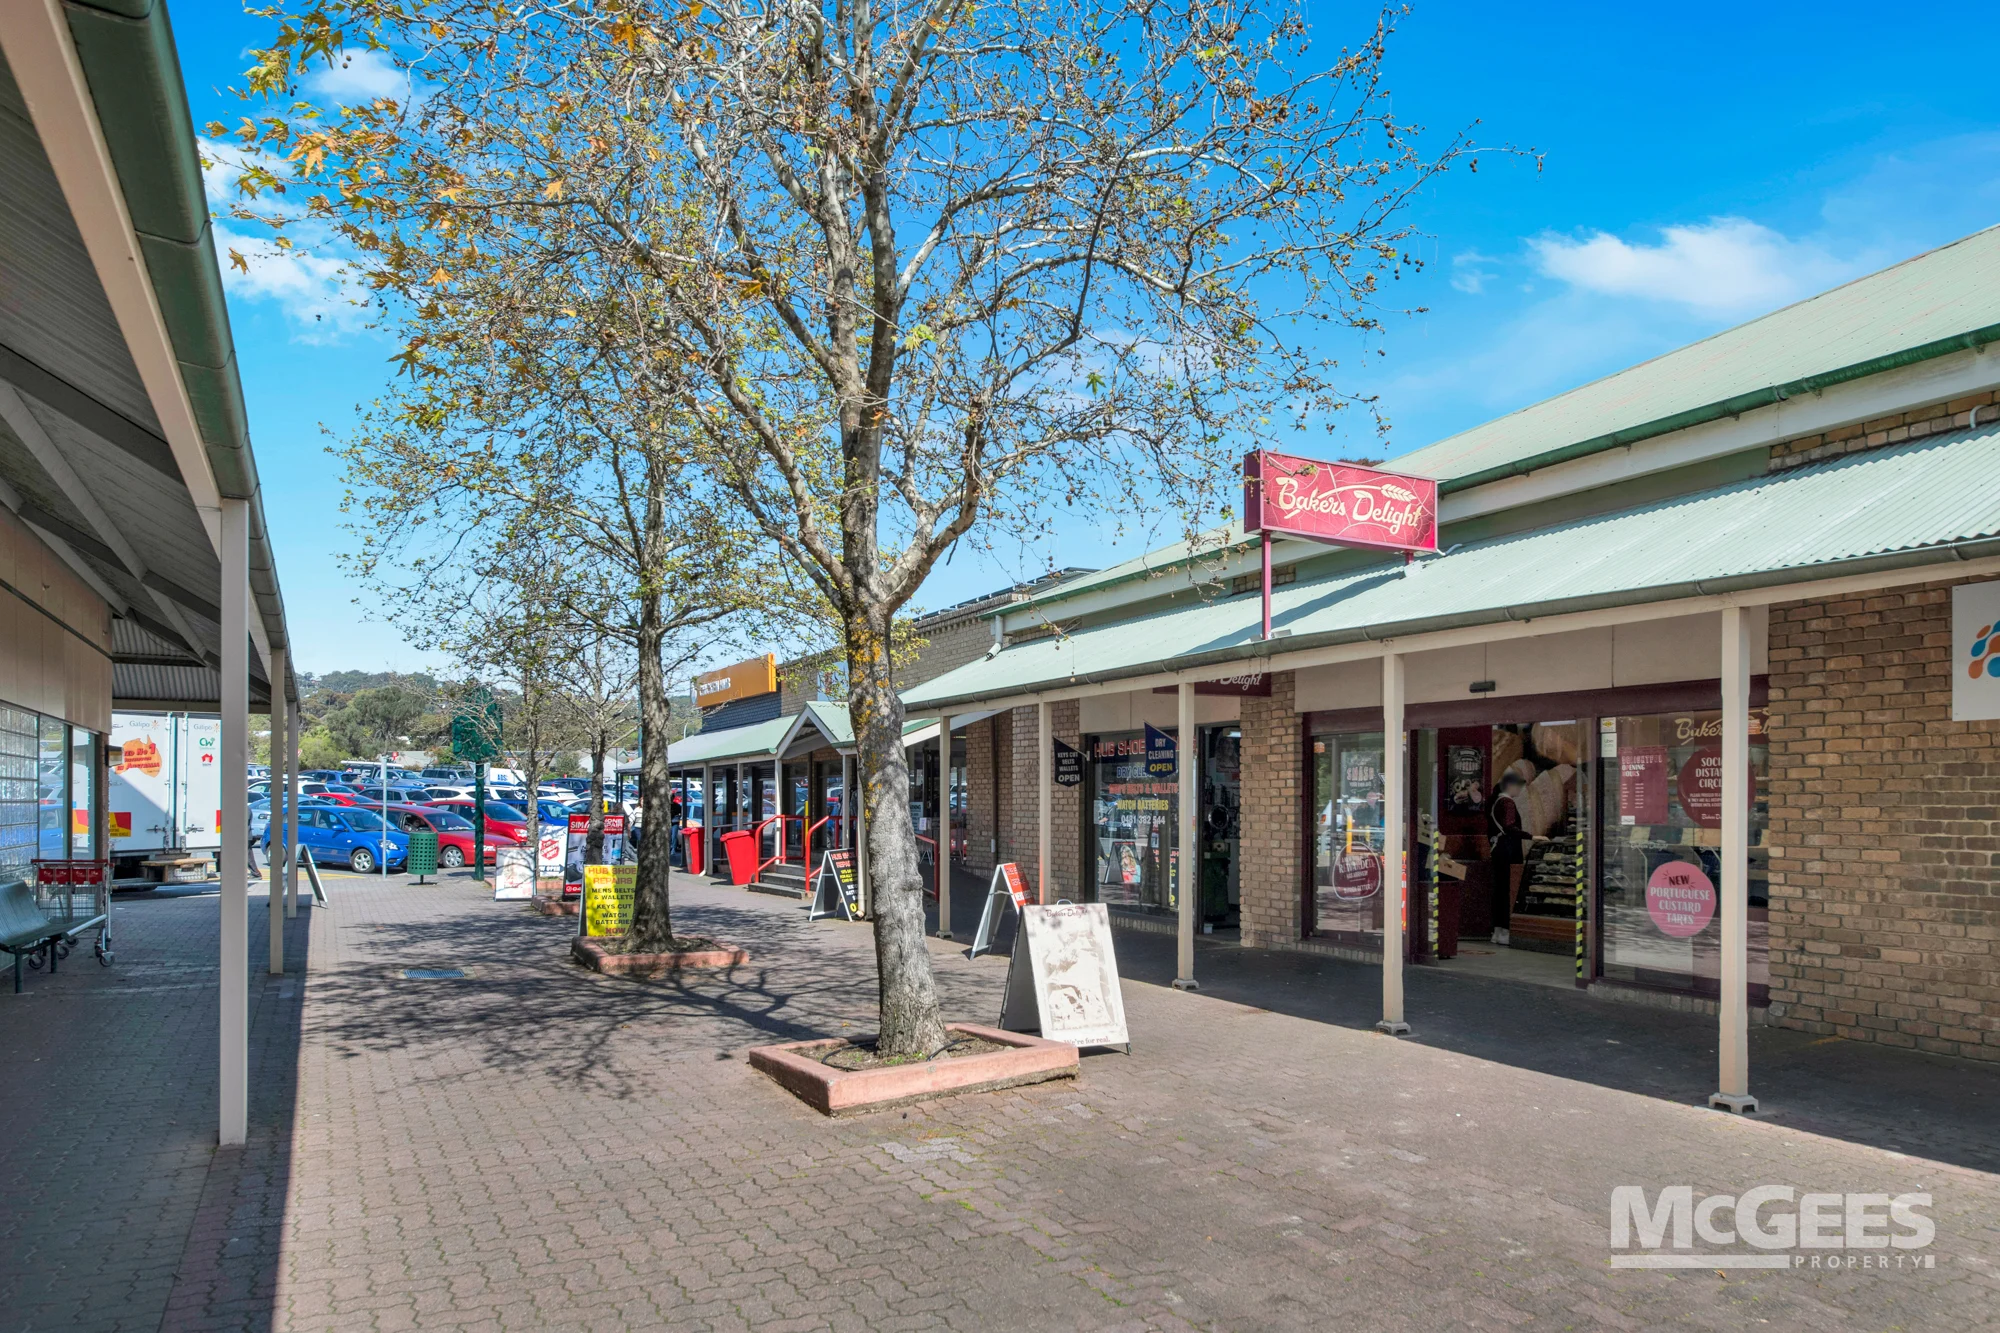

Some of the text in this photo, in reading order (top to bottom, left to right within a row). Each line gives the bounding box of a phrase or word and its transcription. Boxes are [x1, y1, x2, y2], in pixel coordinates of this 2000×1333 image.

[1275, 477, 1423, 535] Bakers Delight
[129, 720, 150, 729] Galipo
[1094, 738, 1145, 757] HUB SHOE
[1154, 738, 1166, 747] DRY
[1148, 750, 1174, 760] CLEANING
[1621, 755, 1663, 764] DELIGHTFUL
[1701, 757, 1722, 767] SOCI
[1116, 765, 1132, 778] DRY
[1149, 763, 1173, 772] OPEN
[1058, 774, 1080, 782] OPEN
[1151, 782, 1178, 794] WALLETS
[1116, 799, 1169, 810] WATCH BATTERIES
[588, 867, 637, 875] HUB SHOE
[593, 877, 633, 885] REPAIRS
[1668, 875, 1690, 886] NEW
[1650, 887, 1711, 901] PORTUGUESE
[1658, 900, 1702, 914] CUSTARD
[1667, 912, 1695, 926] TARTS
[1096, 1035, 1111, 1043] real.
